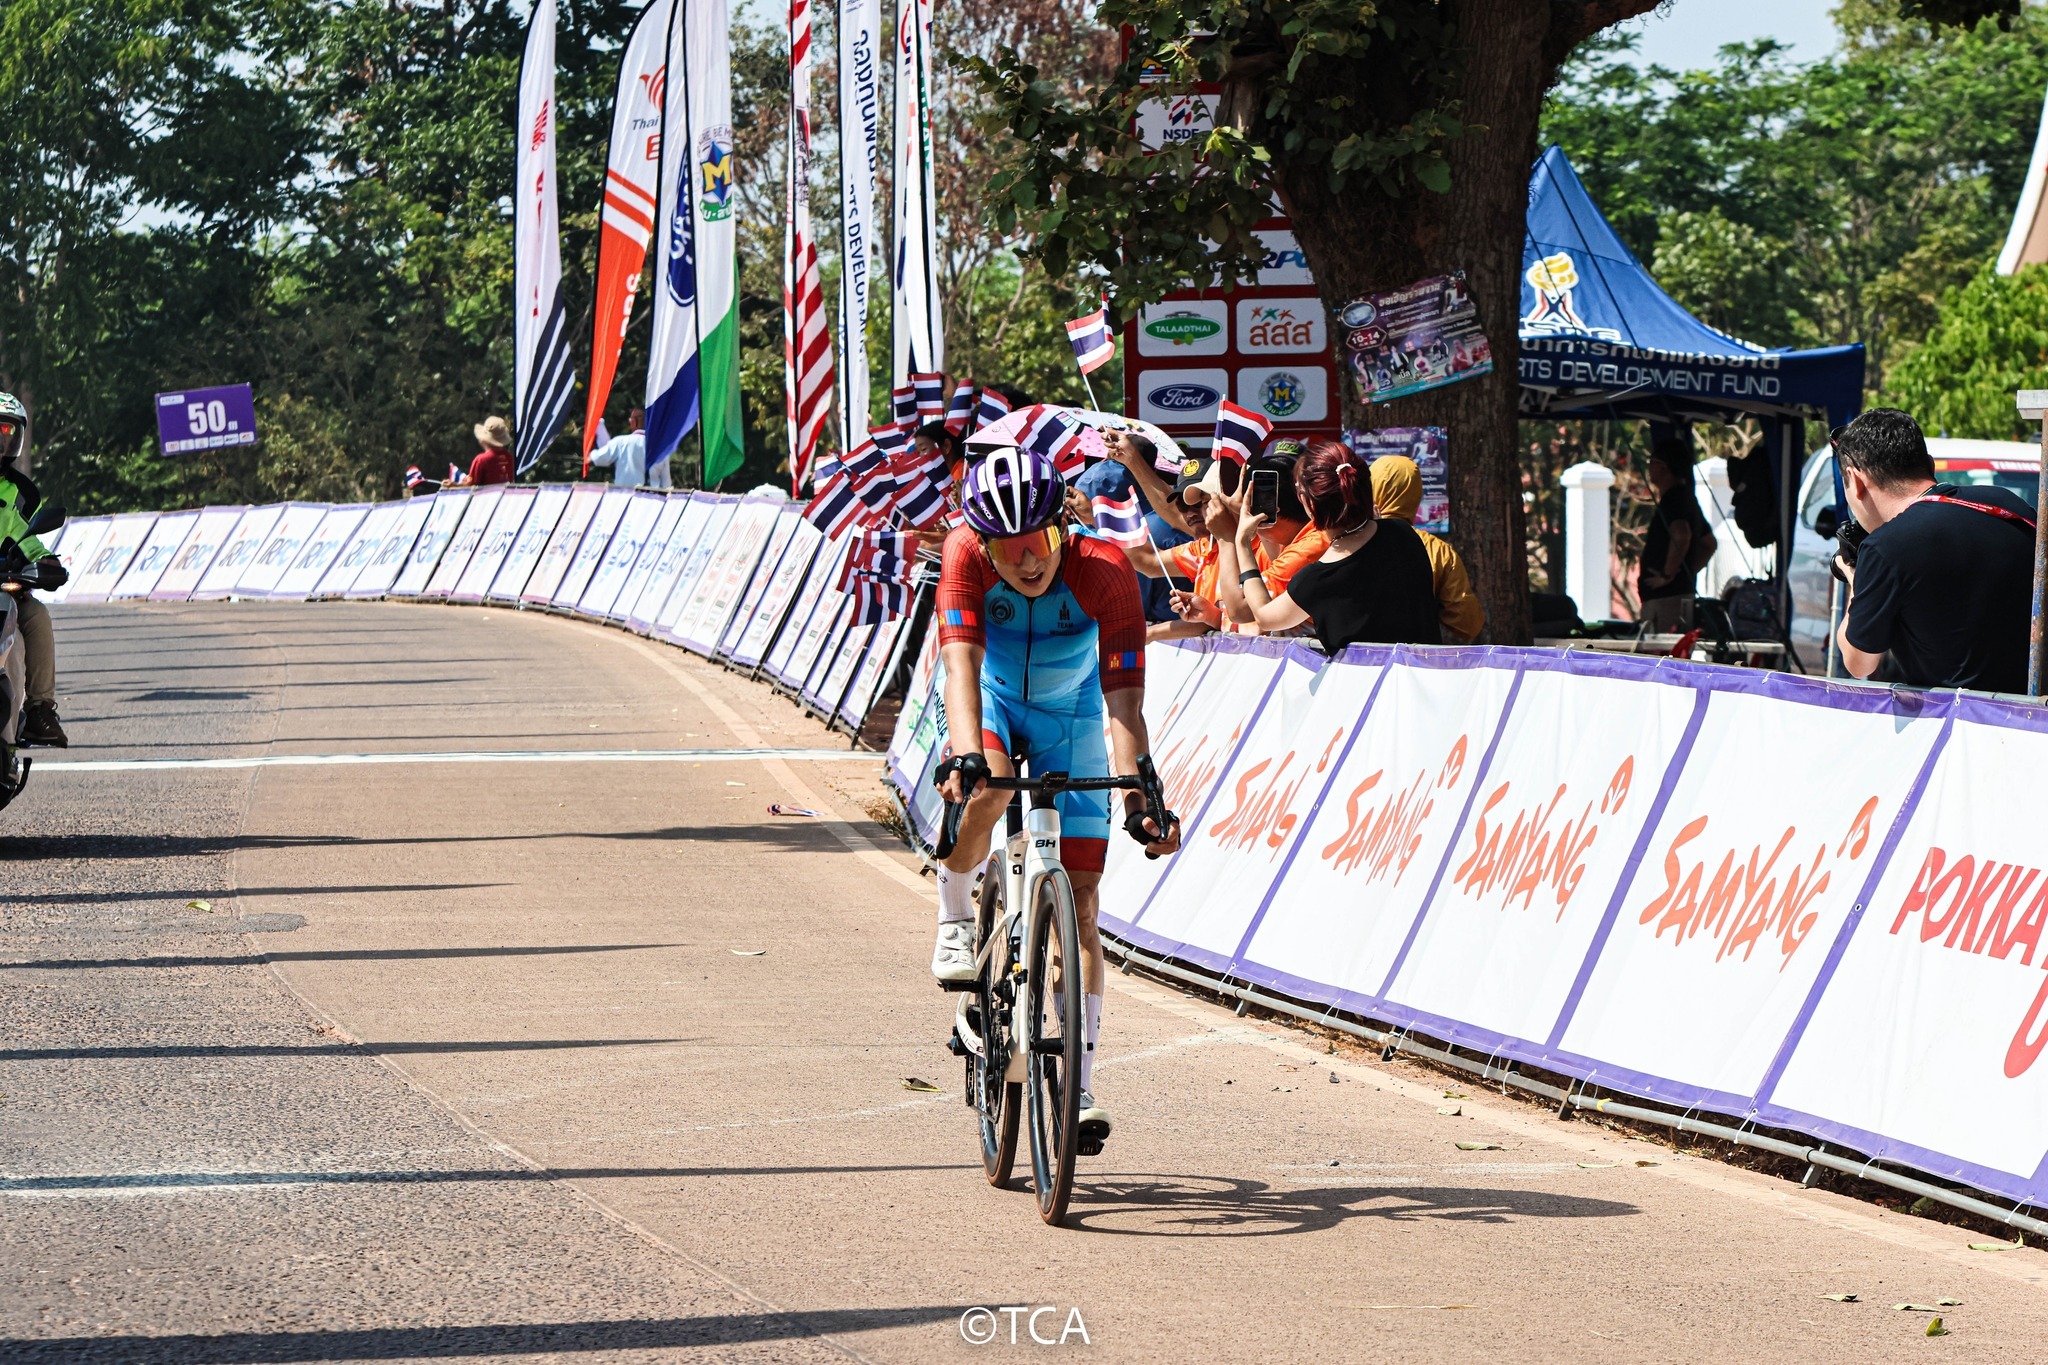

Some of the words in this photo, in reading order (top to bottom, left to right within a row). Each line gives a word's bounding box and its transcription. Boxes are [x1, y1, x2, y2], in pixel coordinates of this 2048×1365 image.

[632, 116, 659, 131] Thai
[702, 152, 732, 193] M
[1155, 325, 1211, 334] TALAADTHAI
[1249, 321, 1313, 347] สสส
[1352, 331, 1380, 345] 10-14
[1559, 360, 1716, 392] DEVELOPMENT
[1722, 373, 1781, 396] FUND
[1162, 388, 1205, 407] Ford
[188, 400, 226, 435] 50
[933, 689, 949, 741] ONGOLIA
[1035, 840, 1056, 848] BH
[1321, 768, 1434, 888] SAMYANG
[1453, 781, 1599, 924] SAMYANG
[1639, 815, 1832, 973] SAMYANG
[1889, 847, 2048, 970] POKKA
